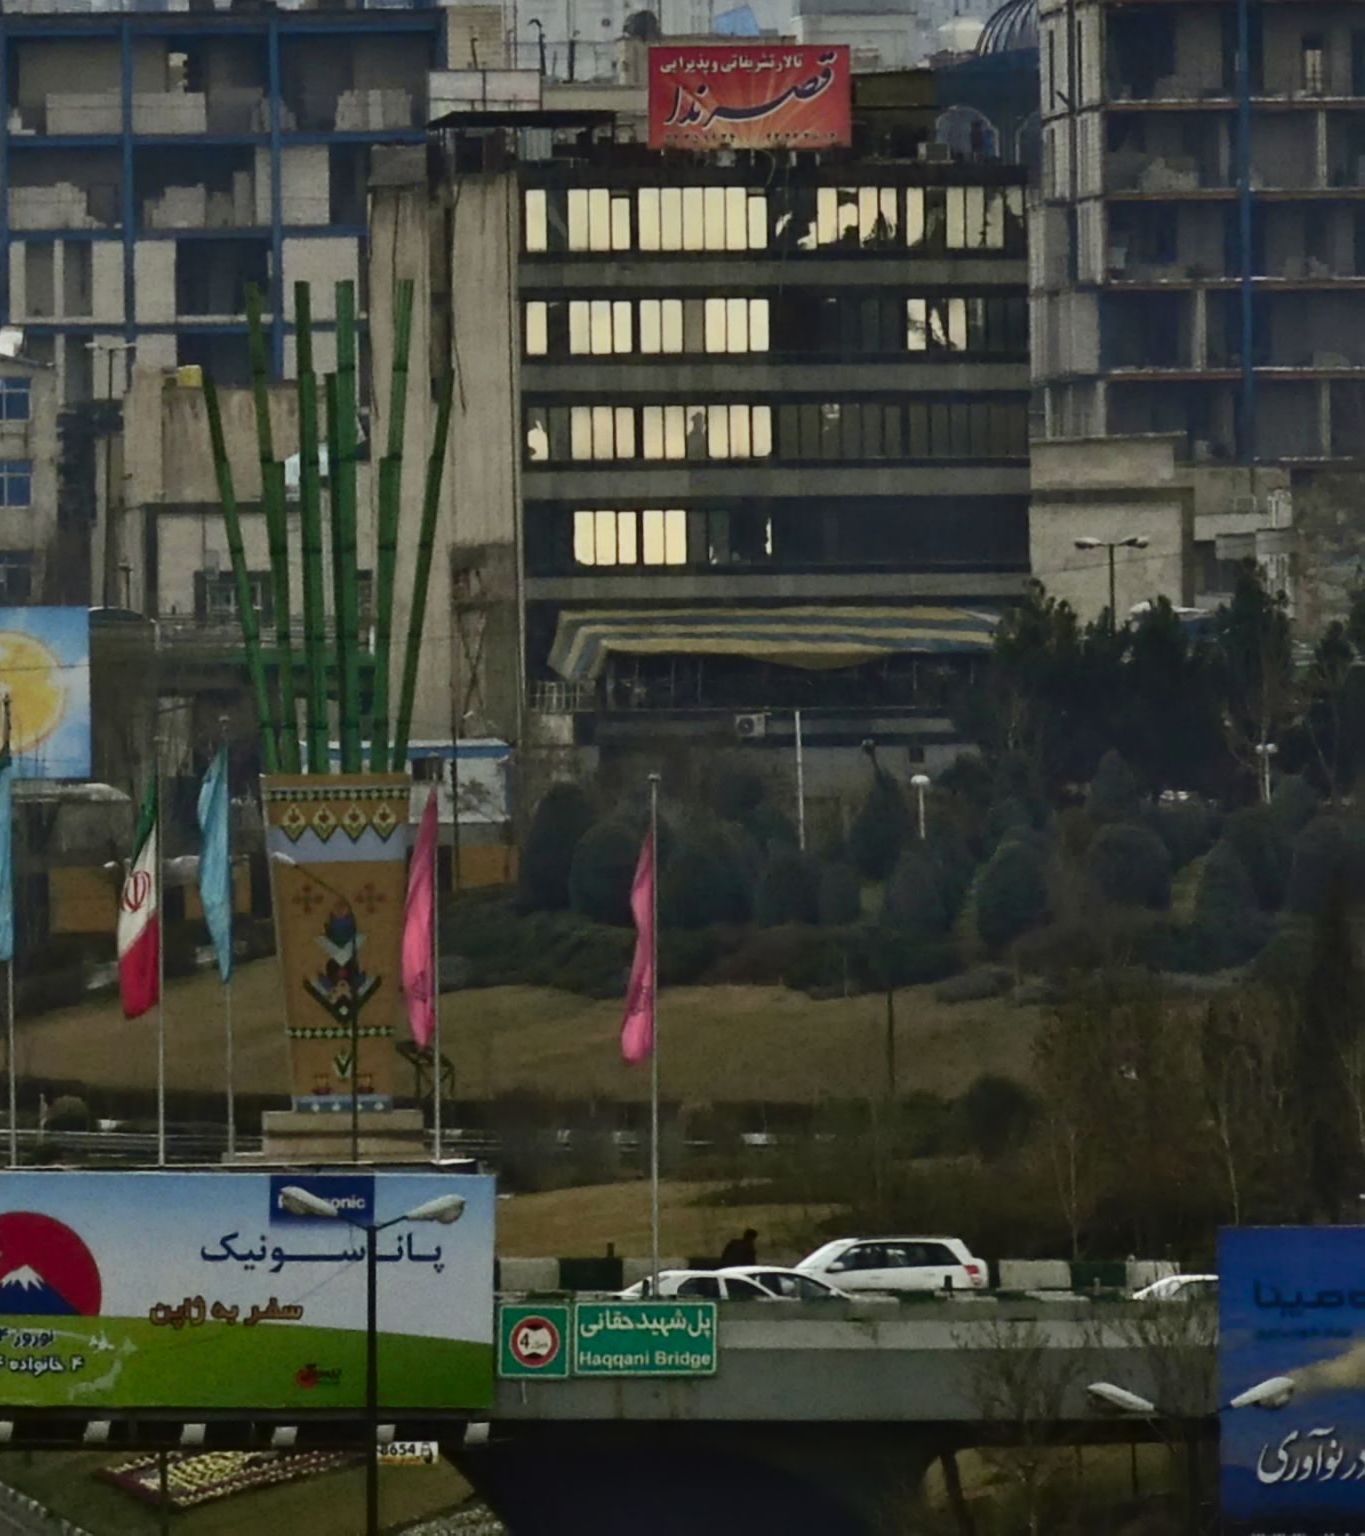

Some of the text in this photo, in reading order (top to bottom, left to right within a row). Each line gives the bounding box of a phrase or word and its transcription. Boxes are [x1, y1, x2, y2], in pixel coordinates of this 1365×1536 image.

[721, 54, 776, 73] تشریفاتی
[777, 53, 803, 72] تالار
[149, 1295, 305, 1330] سفر به ژاپن
[579, 1309, 711, 1339] پل شهید حقانی
[13, 1329, 55, 1348] نوروز
[520, 1333, 529, 1349] 4
[9, 1355, 64, 1376] خانواده
[578, 1350, 712, 1368] Haqqani Bridge
